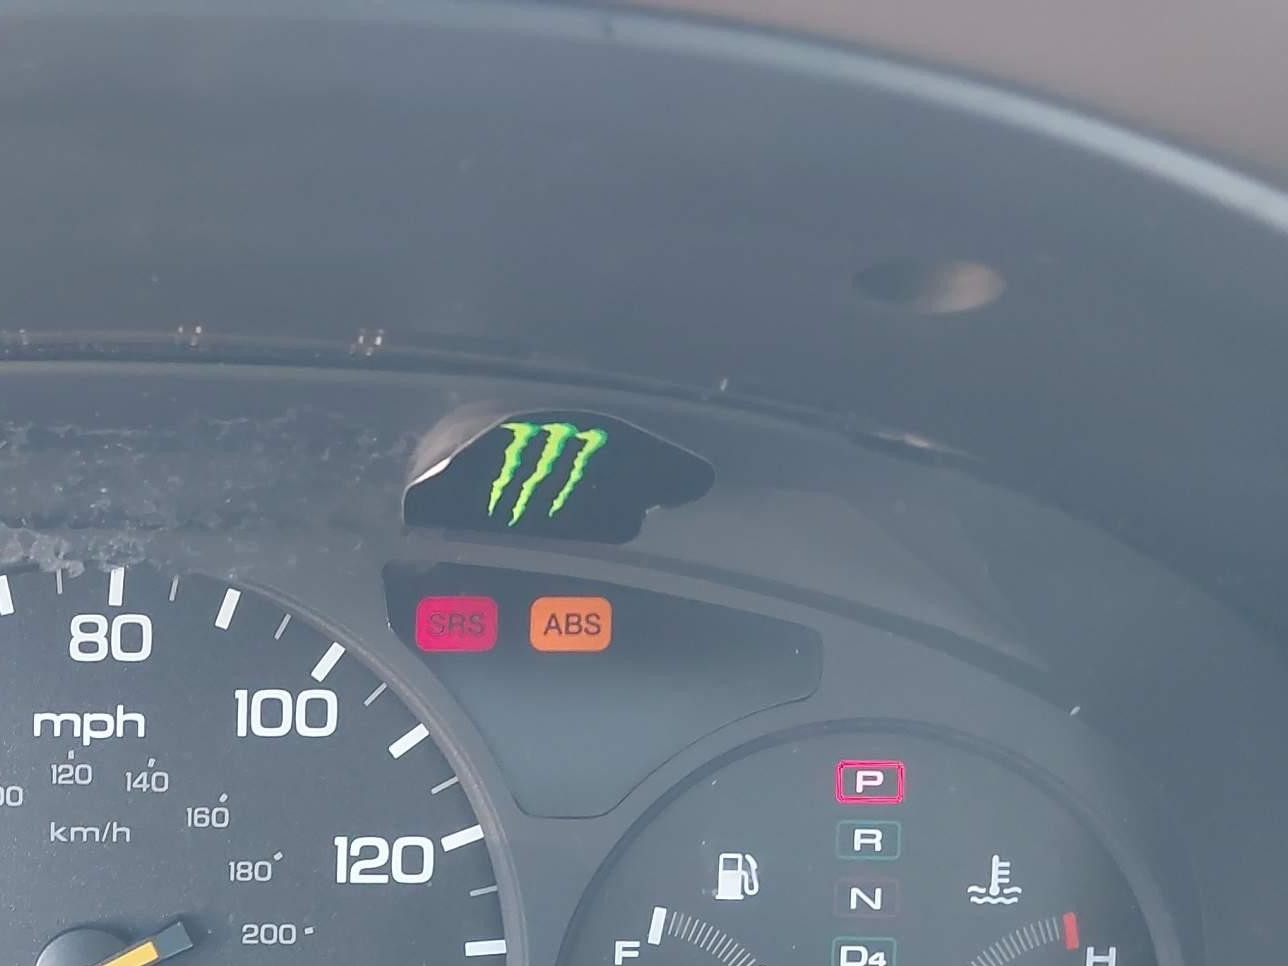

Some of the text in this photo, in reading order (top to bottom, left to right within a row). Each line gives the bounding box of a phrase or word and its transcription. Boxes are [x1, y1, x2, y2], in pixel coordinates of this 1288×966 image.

[427, 610, 486, 638] SRS
[543, 612, 601, 636] ABS
[69, 613, 153, 662] 80
[234, 689, 338, 737] 100
[33, 704, 145, 746] mph
[51, 764, 92, 785] 120
[125, 771, 169, 793] 140
[855, 770, 884, 793] P
[186, 807, 230, 828] 160
[50, 821, 131, 843] km/h
[853, 828, 883, 852] R
[228, 860, 272, 882] 180
[334, 836, 434, 884] 120
[850, 887, 882, 910] N
[242, 923, 297, 945] 200
[614, 940, 641, 966] F
